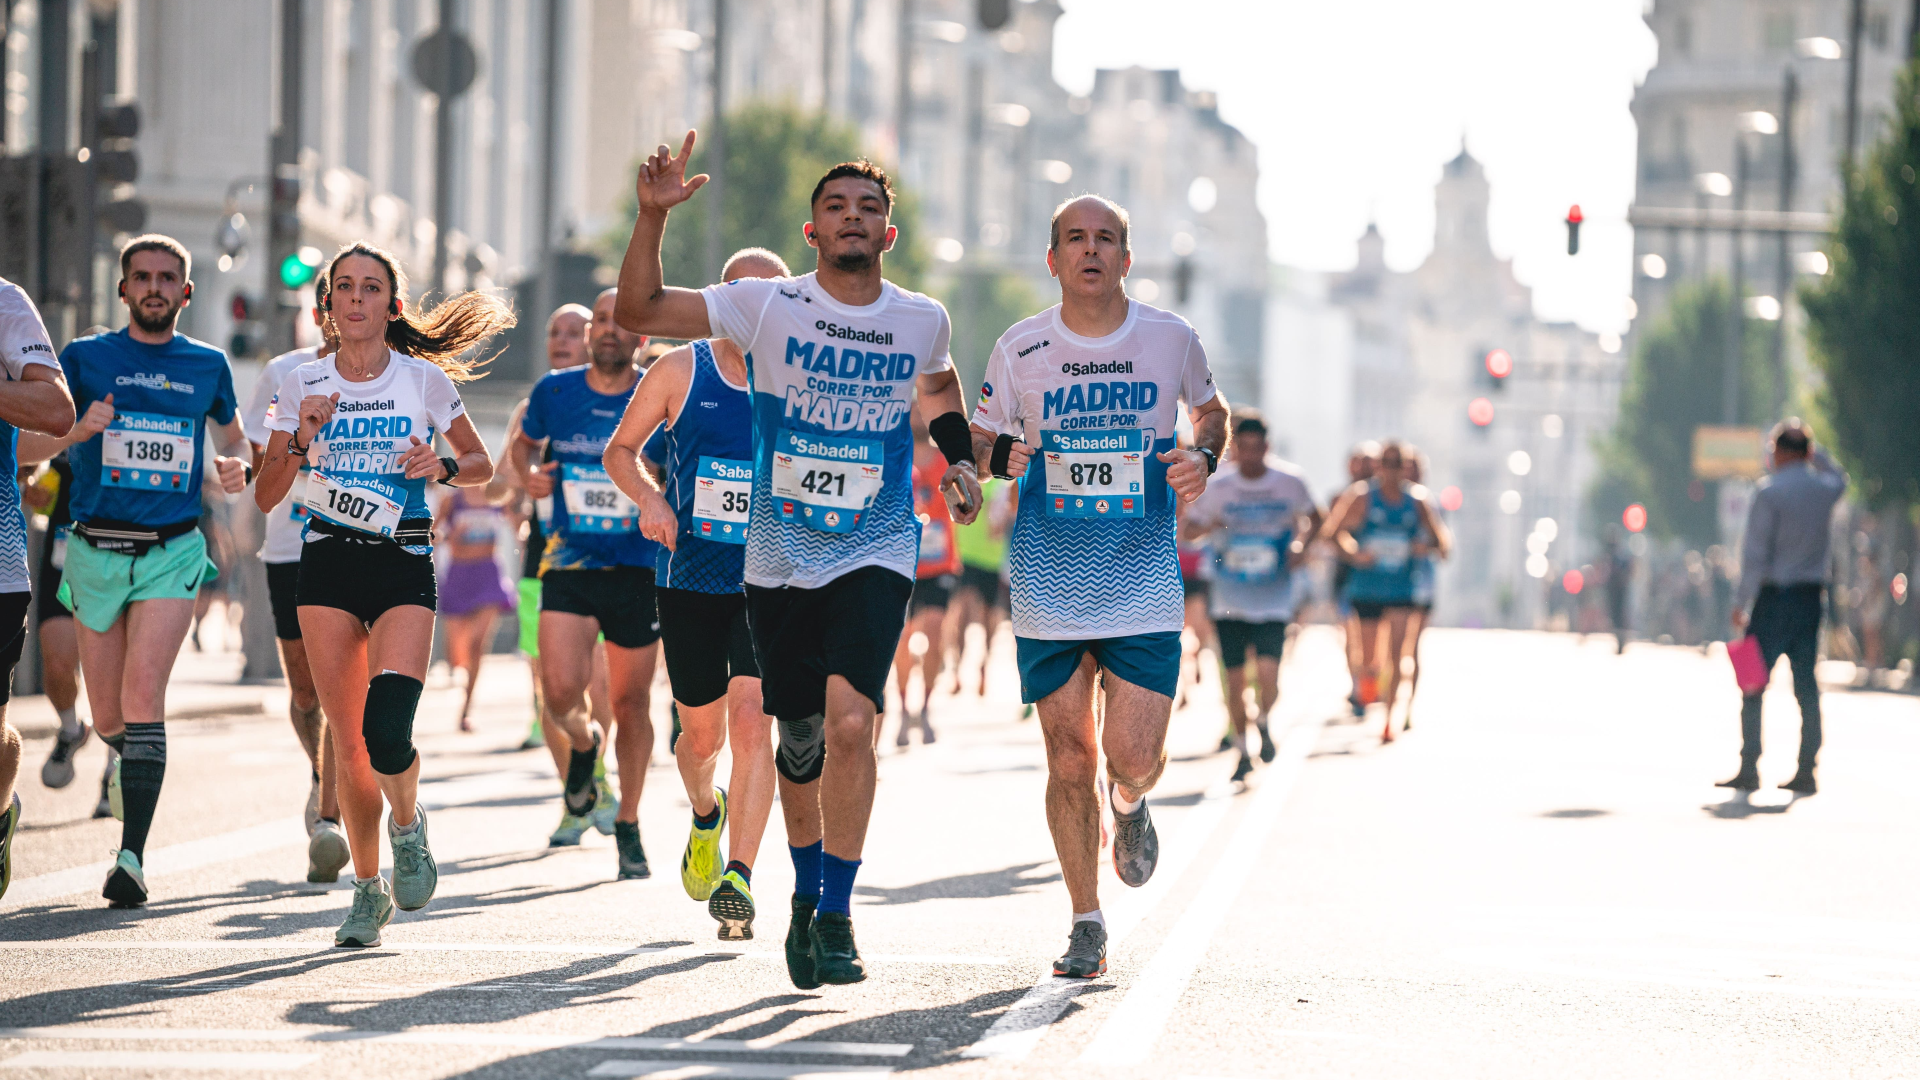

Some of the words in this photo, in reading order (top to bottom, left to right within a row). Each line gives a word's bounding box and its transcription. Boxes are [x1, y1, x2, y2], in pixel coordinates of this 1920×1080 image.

[826, 323, 893, 345] Sabadell
[785, 336, 916, 382] MADRID
[1018, 342, 1041, 358] luanvi
[134, 373, 166, 381] CLUB
[1071, 361, 1133, 376] Sabadell
[807, 377, 859, 397] CORRE
[862, 385, 893, 398] POR
[339, 400, 395, 412] Sabadell
[784, 384, 907, 432] MADRID
[1043, 382, 1158, 420] MADRID
[125, 416, 181, 433] Sabadell
[314, 416, 412, 443] MADRID
[1061, 415, 1107, 430] CORRE
[1109, 414, 1138, 428] POR
[125, 440, 174, 462] 1389
[329, 441, 368, 452] CORRE
[371, 441, 394, 451] POR
[796, 438, 868, 460] Sabadell
[1061, 435, 1127, 449] Sabadell
[801, 470, 845, 496] 421
[1070, 463, 1113, 486] 878
[336, 476, 395, 497] Sabadell
[328, 489, 379, 522] 1807
[585, 490, 617, 508] 862
